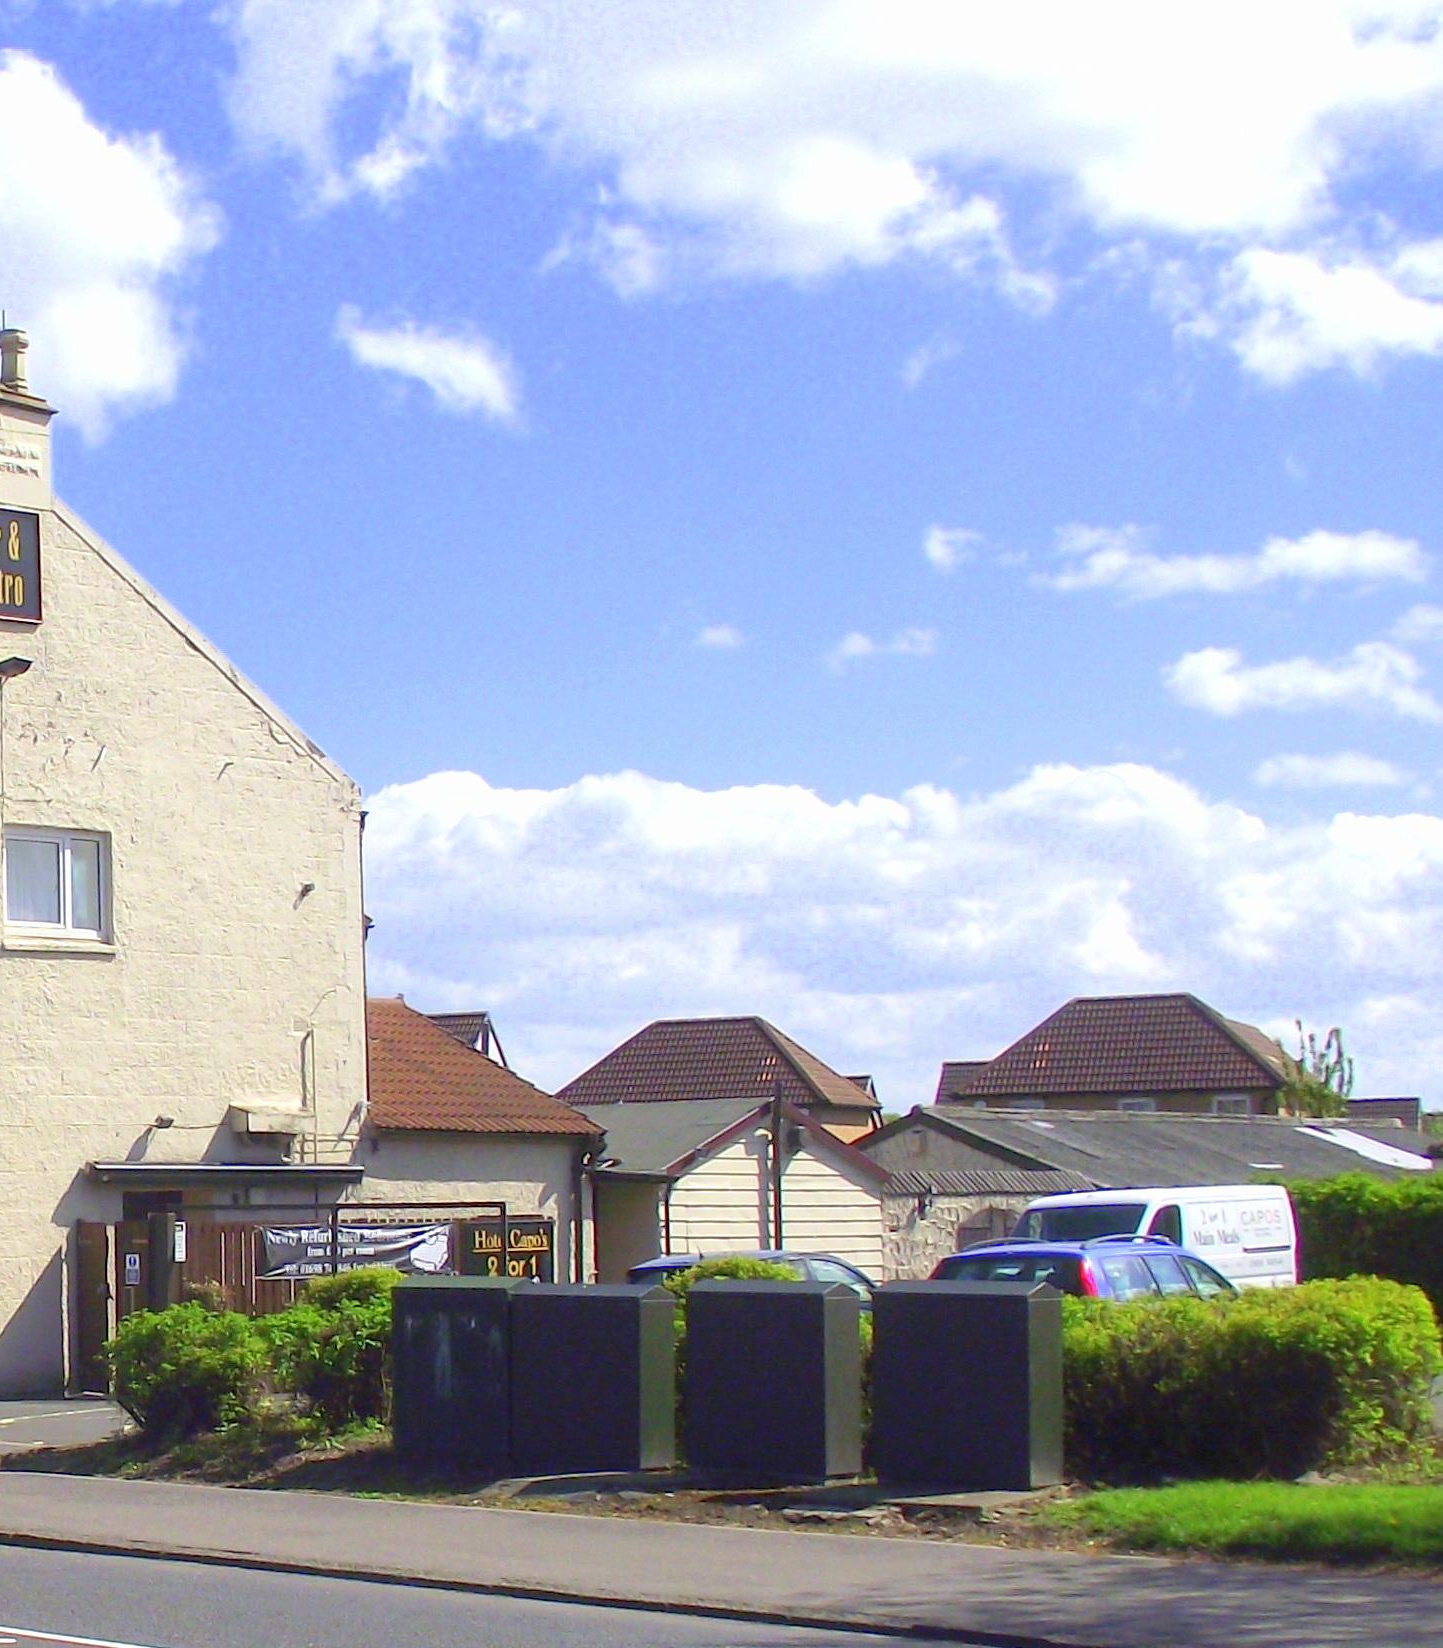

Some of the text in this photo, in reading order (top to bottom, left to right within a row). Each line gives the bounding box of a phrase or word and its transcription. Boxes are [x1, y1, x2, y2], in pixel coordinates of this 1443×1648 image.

[8, 520, 20, 561] &
[1240, 1209, 1281, 1226] CAPOS
[509, 1228, 549, 1249] Capo's
[487, 1255, 499, 1278] 2
[529, 1254, 537, 1276] 1
